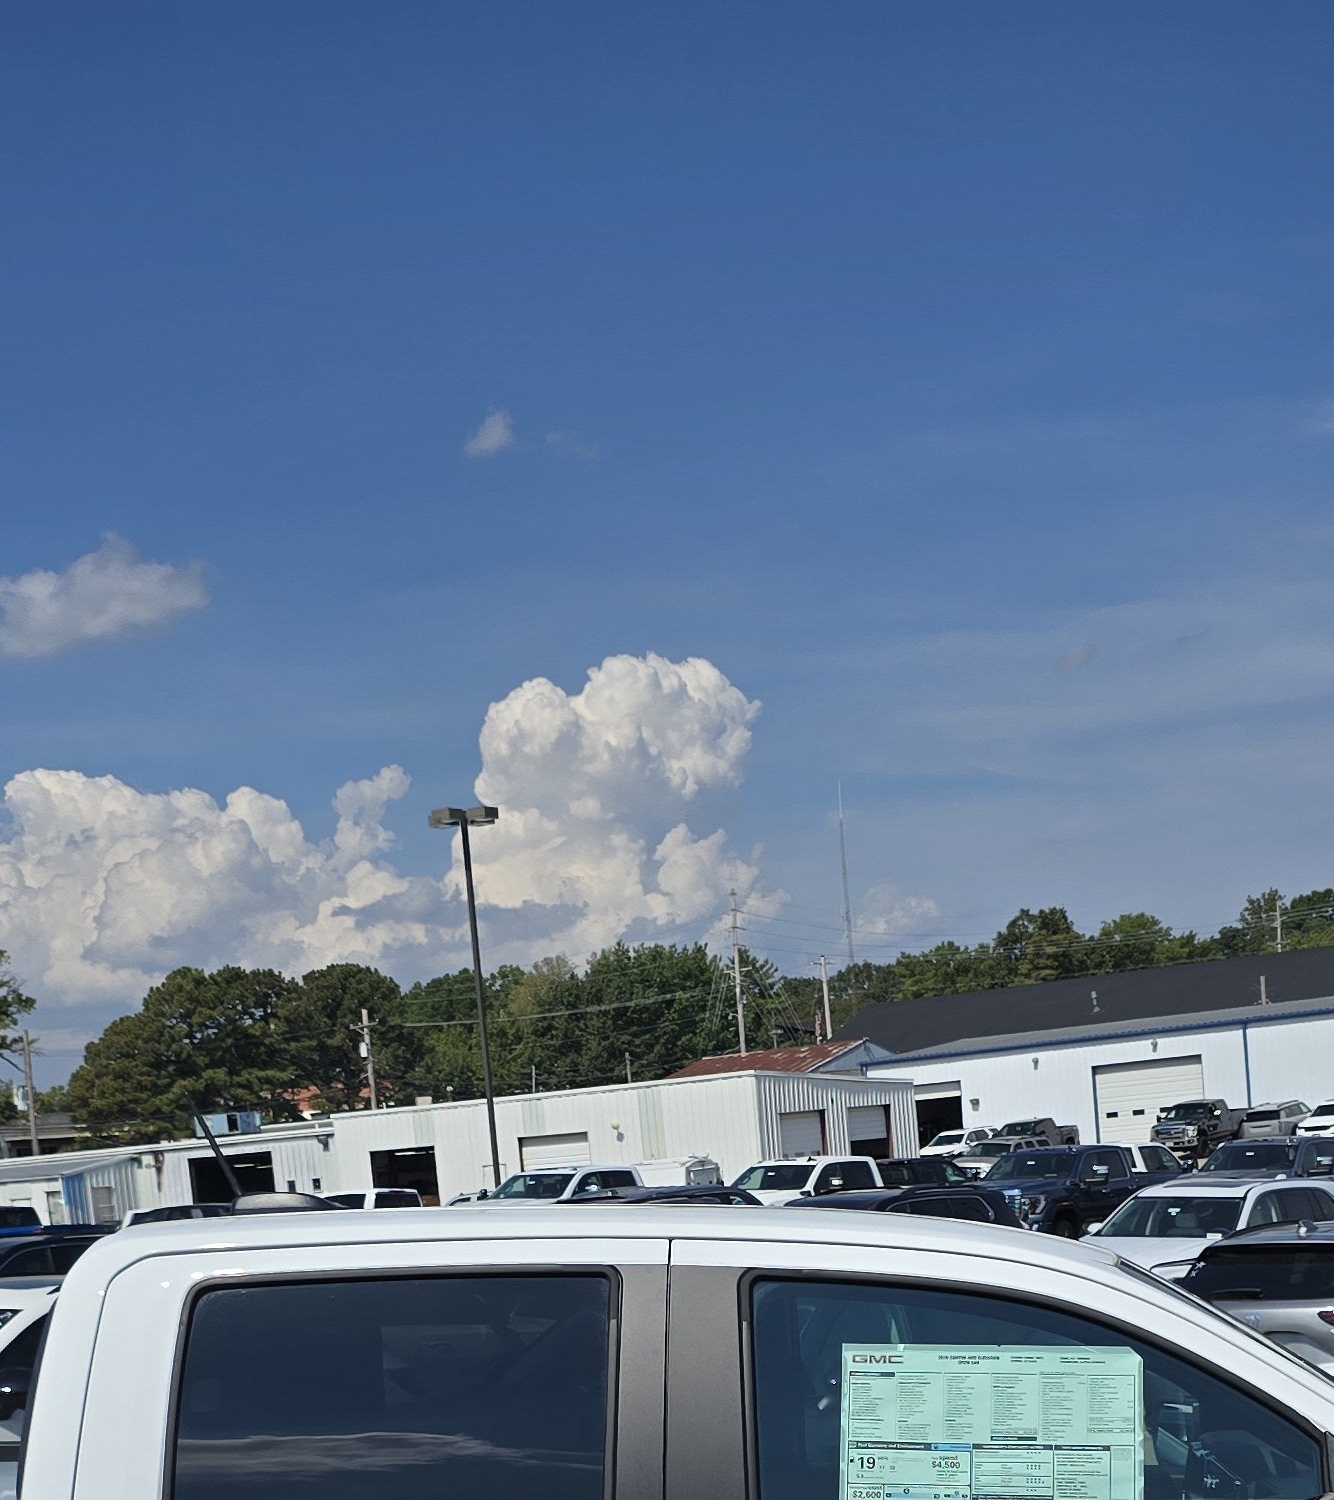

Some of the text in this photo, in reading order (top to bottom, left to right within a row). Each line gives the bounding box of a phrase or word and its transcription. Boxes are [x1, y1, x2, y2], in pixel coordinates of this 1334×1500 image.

[852, 1354, 904, 1364] GMC
[857, 1456, 876, 1469] 19
[931, 1460, 960, 1469] $4,500
[852, 1490, 881, 1500] $2,600
